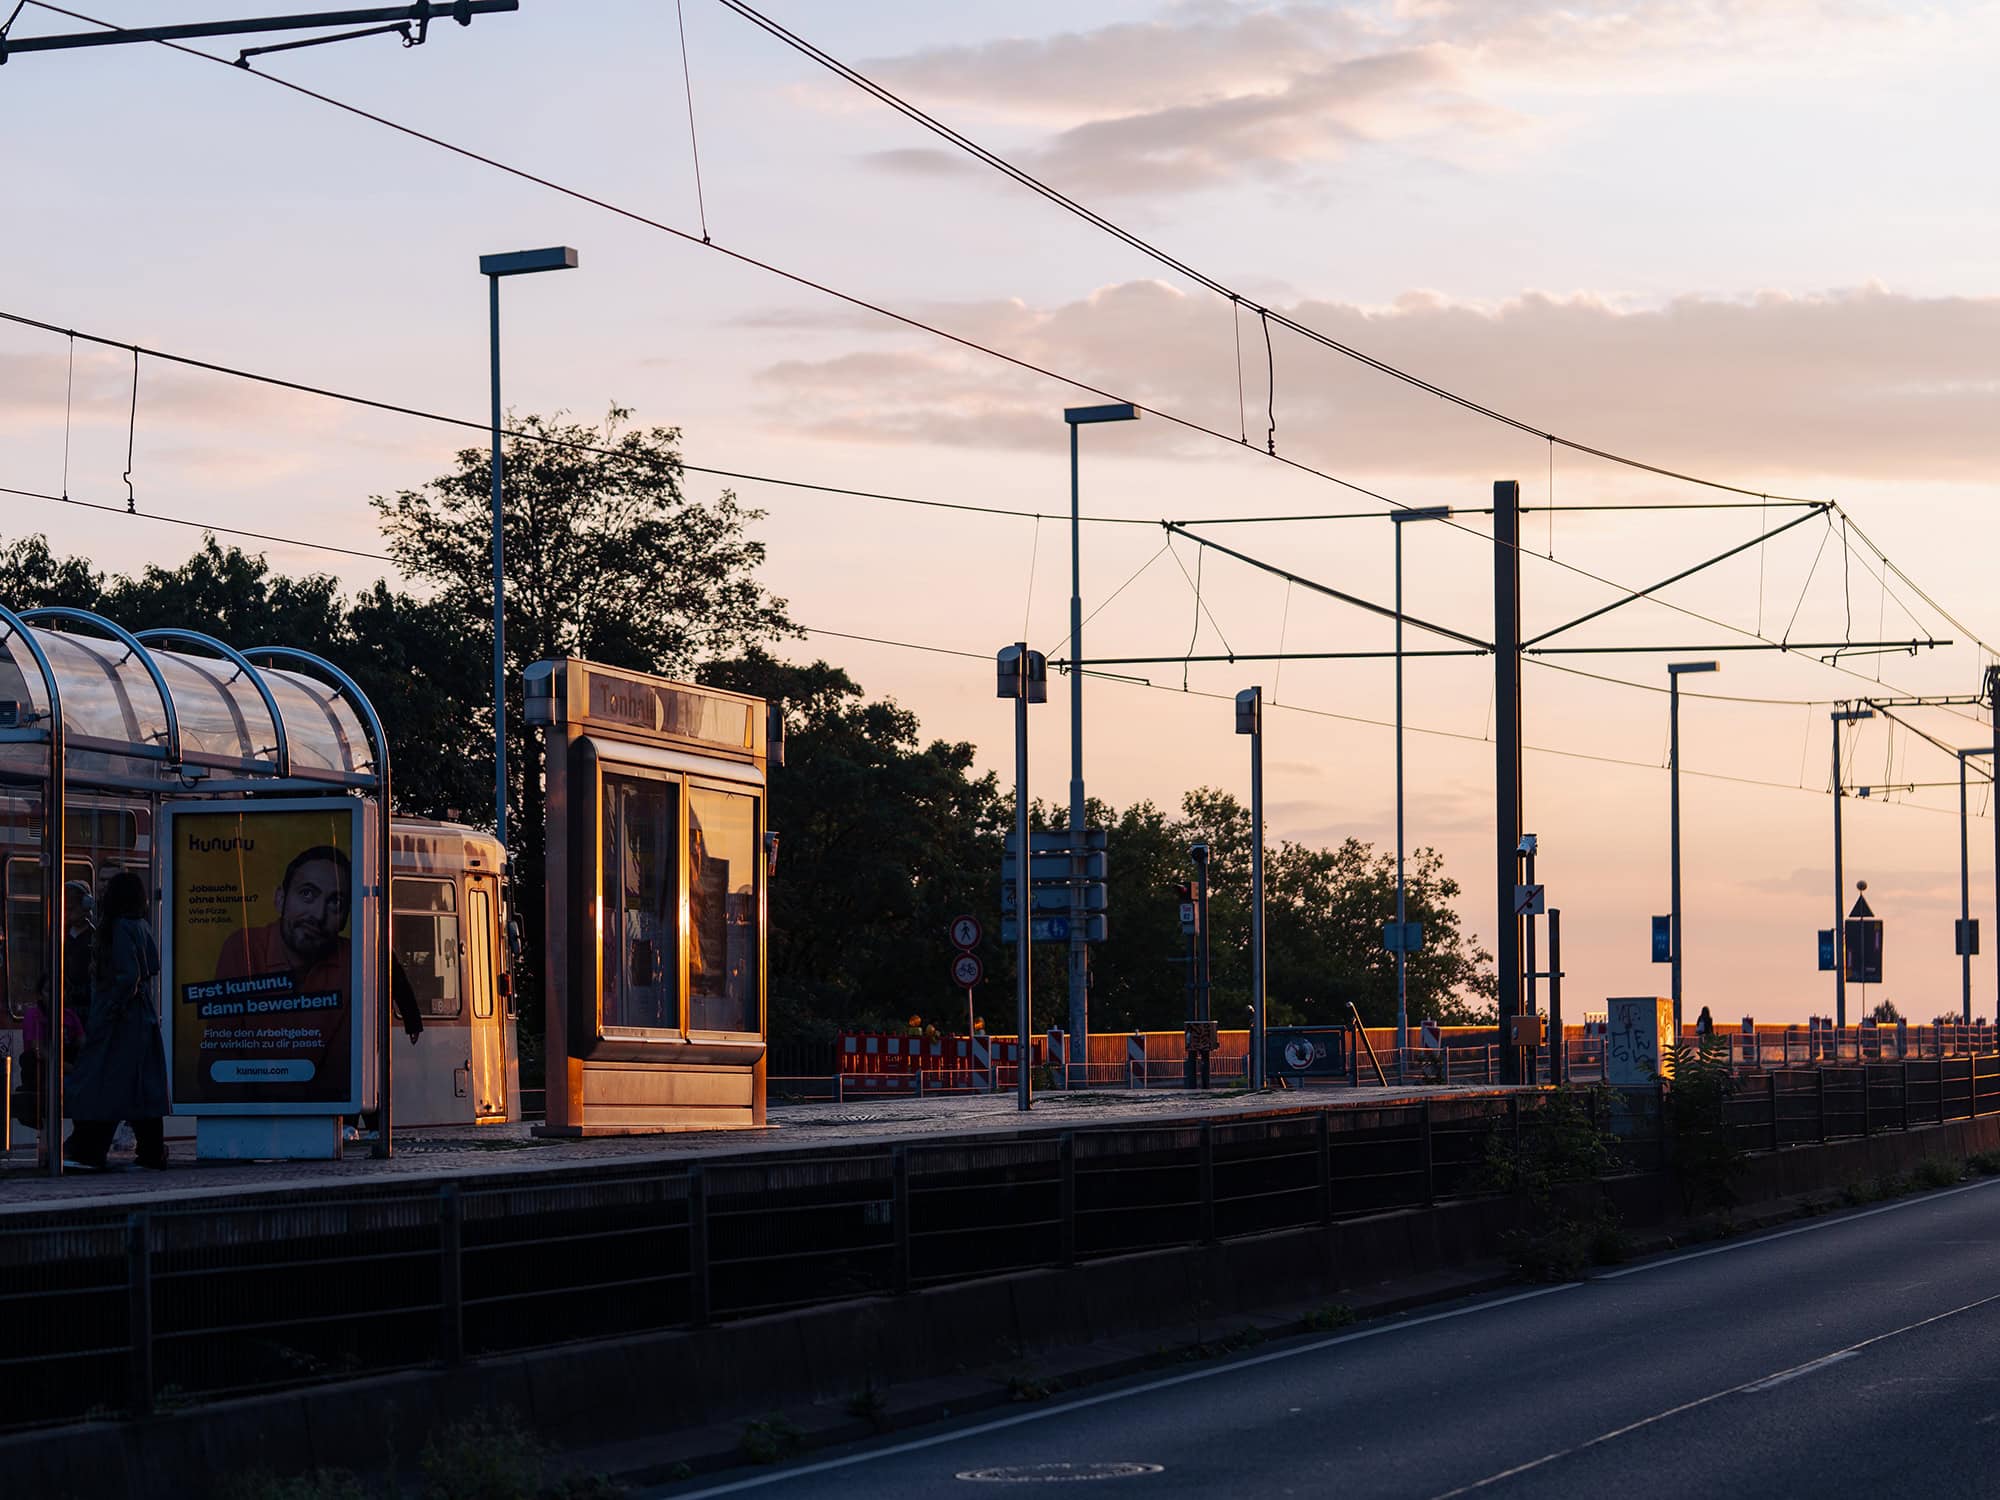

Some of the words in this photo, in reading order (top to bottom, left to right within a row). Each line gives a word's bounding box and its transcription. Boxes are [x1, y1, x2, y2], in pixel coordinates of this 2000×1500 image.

[189, 834, 254, 852] kununu
[189, 884, 237, 893] Jobsuche
[189, 895, 214, 904] ohne
[188, 983, 224, 1000] Erst
[226, 975, 293, 994] kununu,
[202, 1002, 244, 1016] dann
[247, 993, 338, 1013] bewerben!
[203, 1028, 232, 1038] Finde
[234, 1028, 255, 1038] den
[256, 1028, 321, 1040] Arbeitgeber,
[200, 1040, 218, 1049] der
[220, 1040, 261, 1049] wirklich
[262, 1041, 275, 1049] zu
[276, 1039, 290, 1048] dir
[292, 1040, 325, 1050] passt.
[236, 1066, 289, 1075] kununu.com
